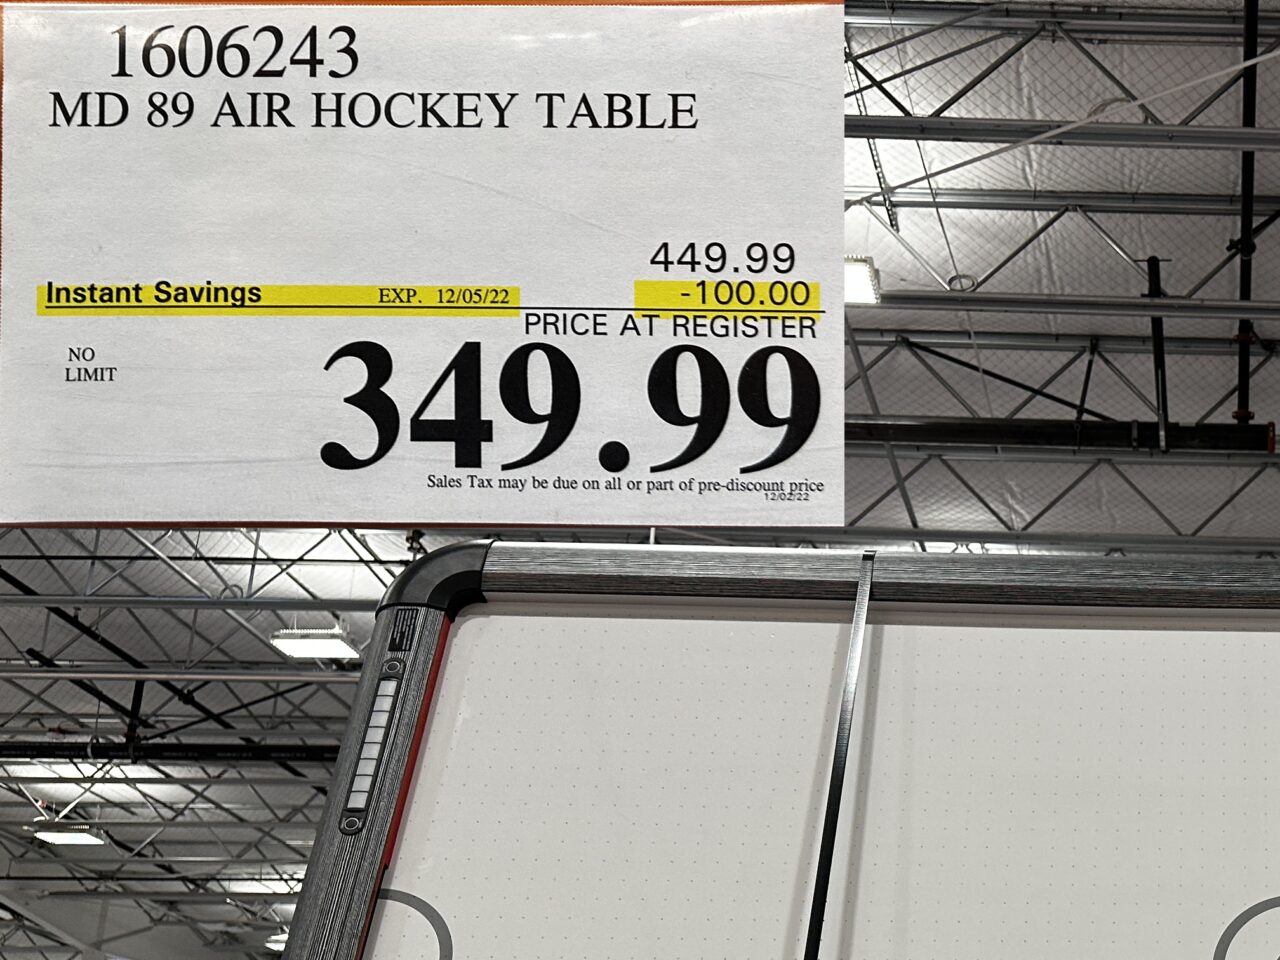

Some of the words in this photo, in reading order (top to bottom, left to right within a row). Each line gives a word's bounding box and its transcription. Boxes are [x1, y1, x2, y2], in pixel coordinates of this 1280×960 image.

[111, 25, 358, 78] 1606243
[49, 92, 128, 128] MD
[147, 92, 194, 128] 89
[211, 92, 295, 128] AIR
[312, 92, 519, 129] HOCKEY
[536, 93, 698, 129] TABLE
[650, 242, 796, 274] 449.99
[46, 282, 142, 303] Instant
[155, 281, 261, 306] Savings
[379, 288, 421, 304] EXP.
[437, 288, 510, 305] 12/05/22
[681, 281, 811, 306] -100.00
[525, 313, 607, 337] PRICE
[620, 315, 660, 337] AT
[673, 315, 817, 338] REGISTER
[68, 348, 95, 362] NO
[65, 366, 117, 382] LIMIT
[321, 341, 821, 474] 349.99
[427, 475, 461, 488] Sales
[467, 475, 493, 488] Tax
[499, 479, 526, 492] may
[532, 476, 548, 489] be
[553, 477, 577, 489] due
[583, 480, 600, 489] on
[605, 477, 621, 489] all
[627, 481, 642, 490] or
[647, 478, 674, 494] part
[679, 478, 694, 490] of
[698, 480, 784, 494] pre-discount
[788, 480, 825, 496] price
